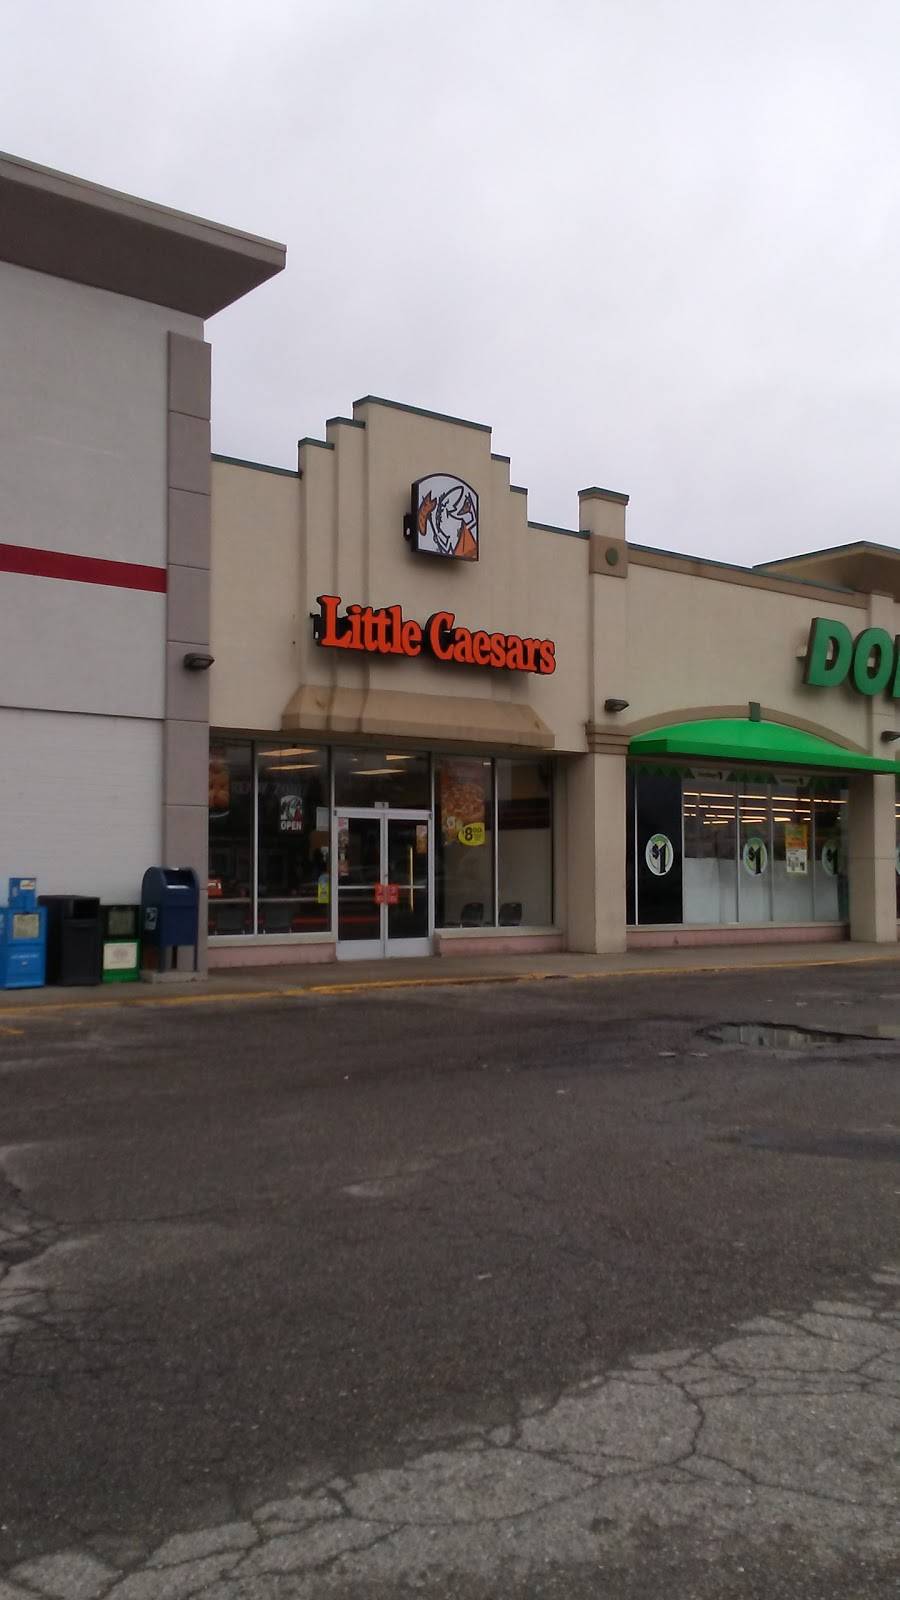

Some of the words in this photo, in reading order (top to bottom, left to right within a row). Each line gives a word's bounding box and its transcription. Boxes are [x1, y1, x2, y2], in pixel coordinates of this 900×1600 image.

[317, 595, 422, 656] Little
[425, 611, 556, 674] Caesars
[803, 617, 900, 698] DO
[281, 821, 302, 830] OPEN
